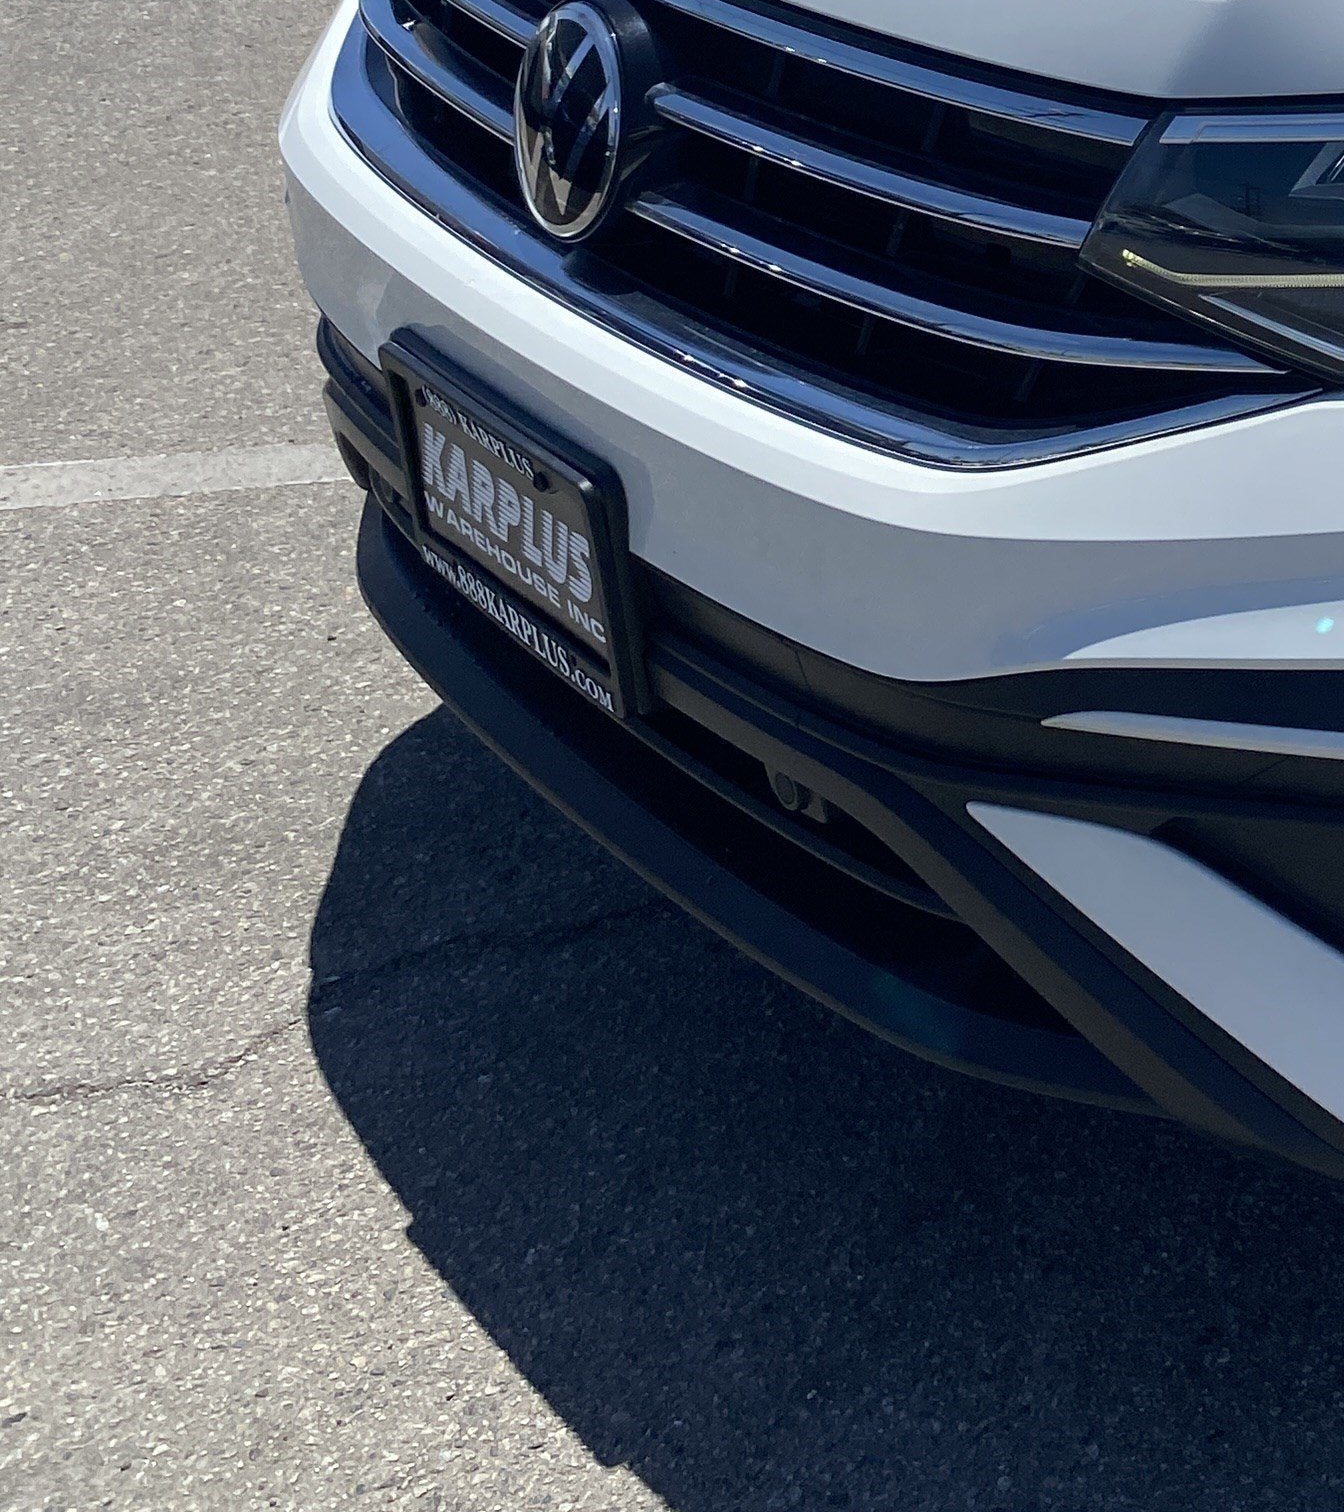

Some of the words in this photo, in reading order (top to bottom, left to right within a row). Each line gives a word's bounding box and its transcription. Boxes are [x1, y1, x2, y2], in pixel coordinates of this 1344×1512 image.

[422, 421, 593, 603] KARPLUS
[456, 410, 535, 482] KARPLUS
[424, 490, 562, 608] WAREHOUSE
[567, 599, 607, 643] INC
